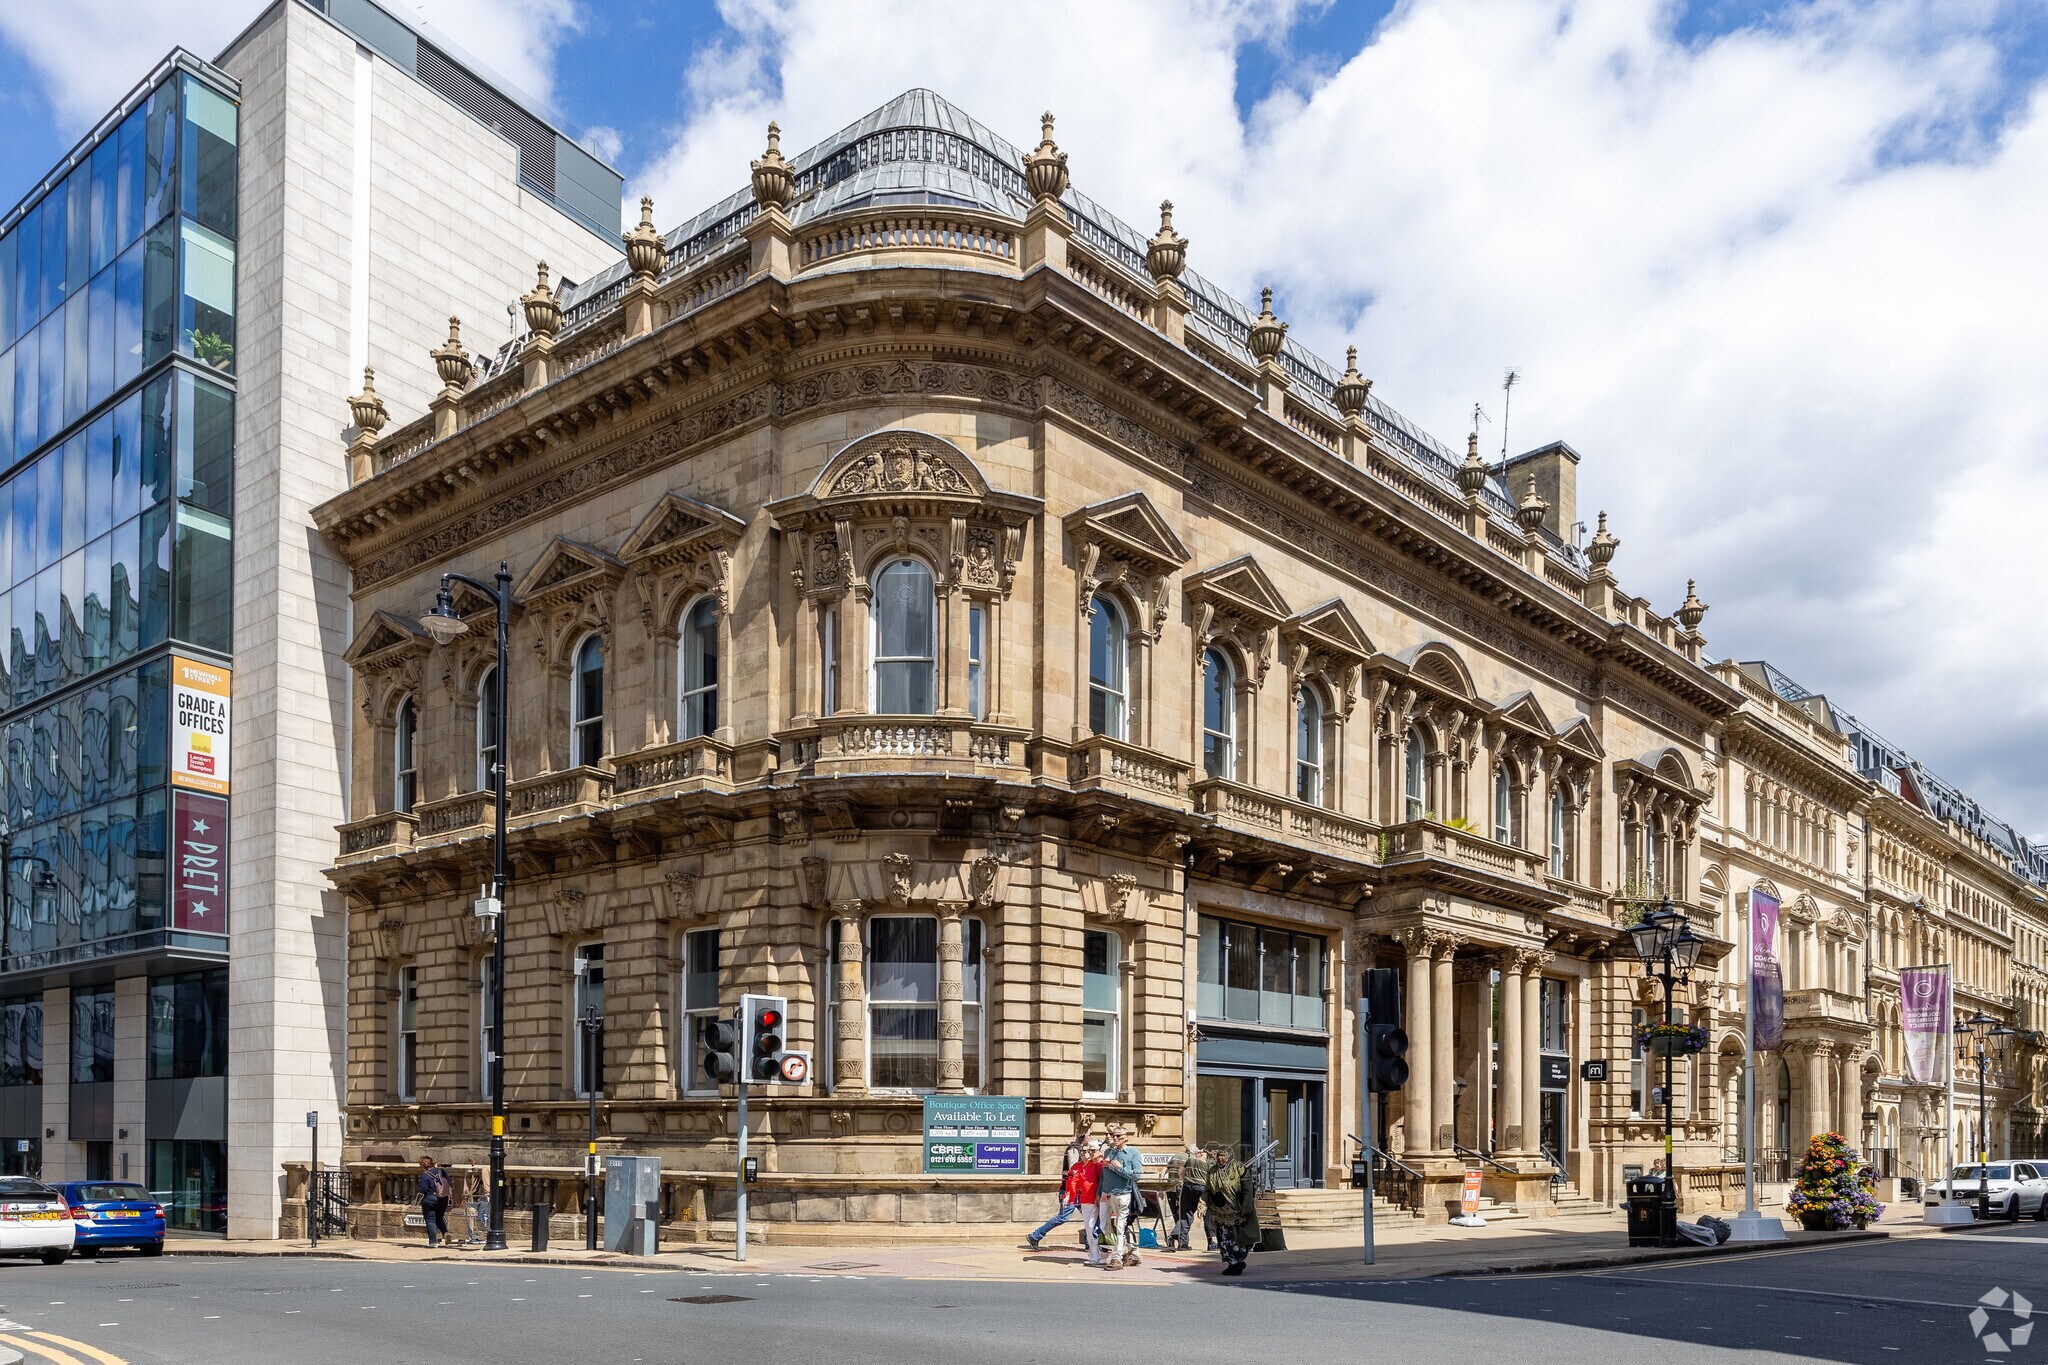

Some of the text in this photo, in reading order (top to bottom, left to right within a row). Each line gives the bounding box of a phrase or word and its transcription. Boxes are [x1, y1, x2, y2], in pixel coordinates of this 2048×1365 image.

[182, 666, 223, 682] 1 NEWHALL
[189, 674, 215, 686] STREET
[178, 692, 226, 718] GRADE A
[179, 710, 224, 735] OFFICES
[191, 744, 212, 754] savills
[190, 754, 212, 763] Lambert
[190, 759, 205, 767] Smith
[190, 764, 213, 773] Hampton
[183, 840, 218, 896] PRET
[1471, 902, 1483, 919] 85
[1495, 908, 1507, 925] 89
[929, 1100, 1021, 1111] Boutique Office Space
[933, 1111, 1016, 1122] Available To Let
[1442, 1132, 1452, 1141] 85
[1508, 1132, 1519, 1141] 85
[930, 1145, 962, 1154] CBRE
[1001, 1145, 1017, 1153] Jonas
